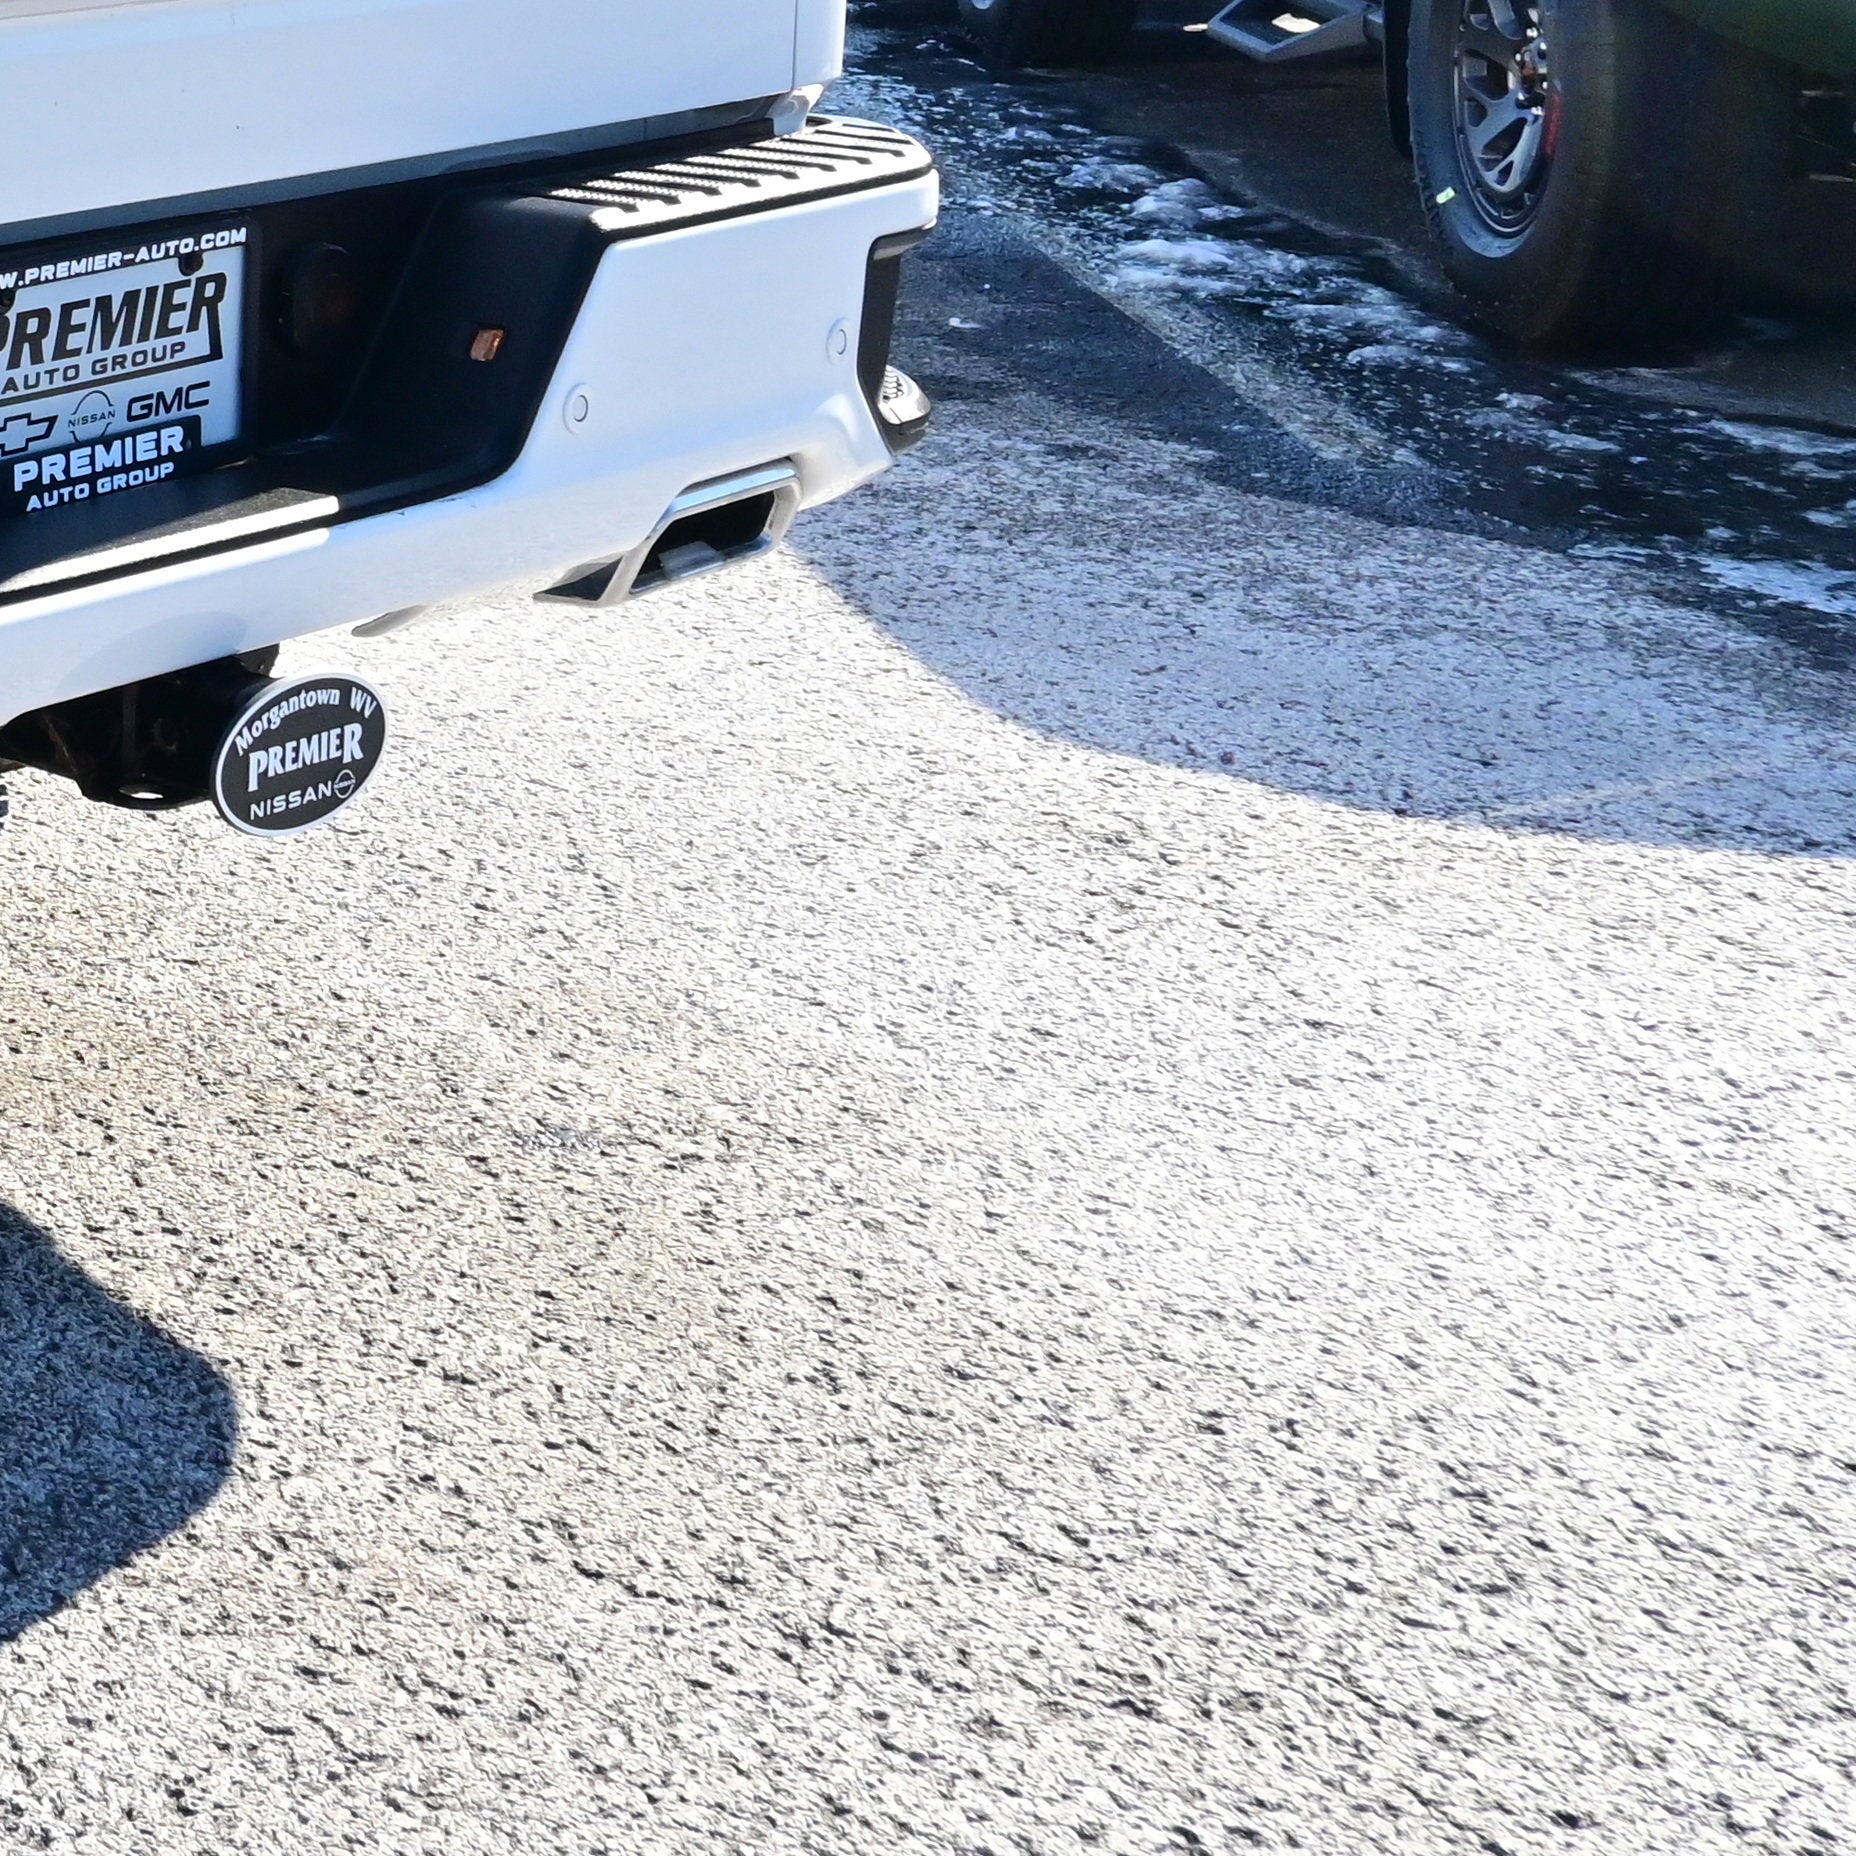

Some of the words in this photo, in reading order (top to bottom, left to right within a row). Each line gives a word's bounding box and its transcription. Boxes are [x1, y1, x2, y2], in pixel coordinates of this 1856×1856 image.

[1, 363, 80, 395] AUTO
[91, 341, 186, 376] GROUP
[67, 408, 116, 429] NISSAN
[126, 381, 211, 423] GMC
[13, 425, 184, 492] PREMIER
[26, 481, 89, 512] AUTO
[96, 462, 174, 495] GROUP
[234, 688, 341, 757] Morgantown
[350, 686, 378, 719] WV
[248, 722, 364, 793] PREMIER
[250, 780, 332, 820] NISSAN
